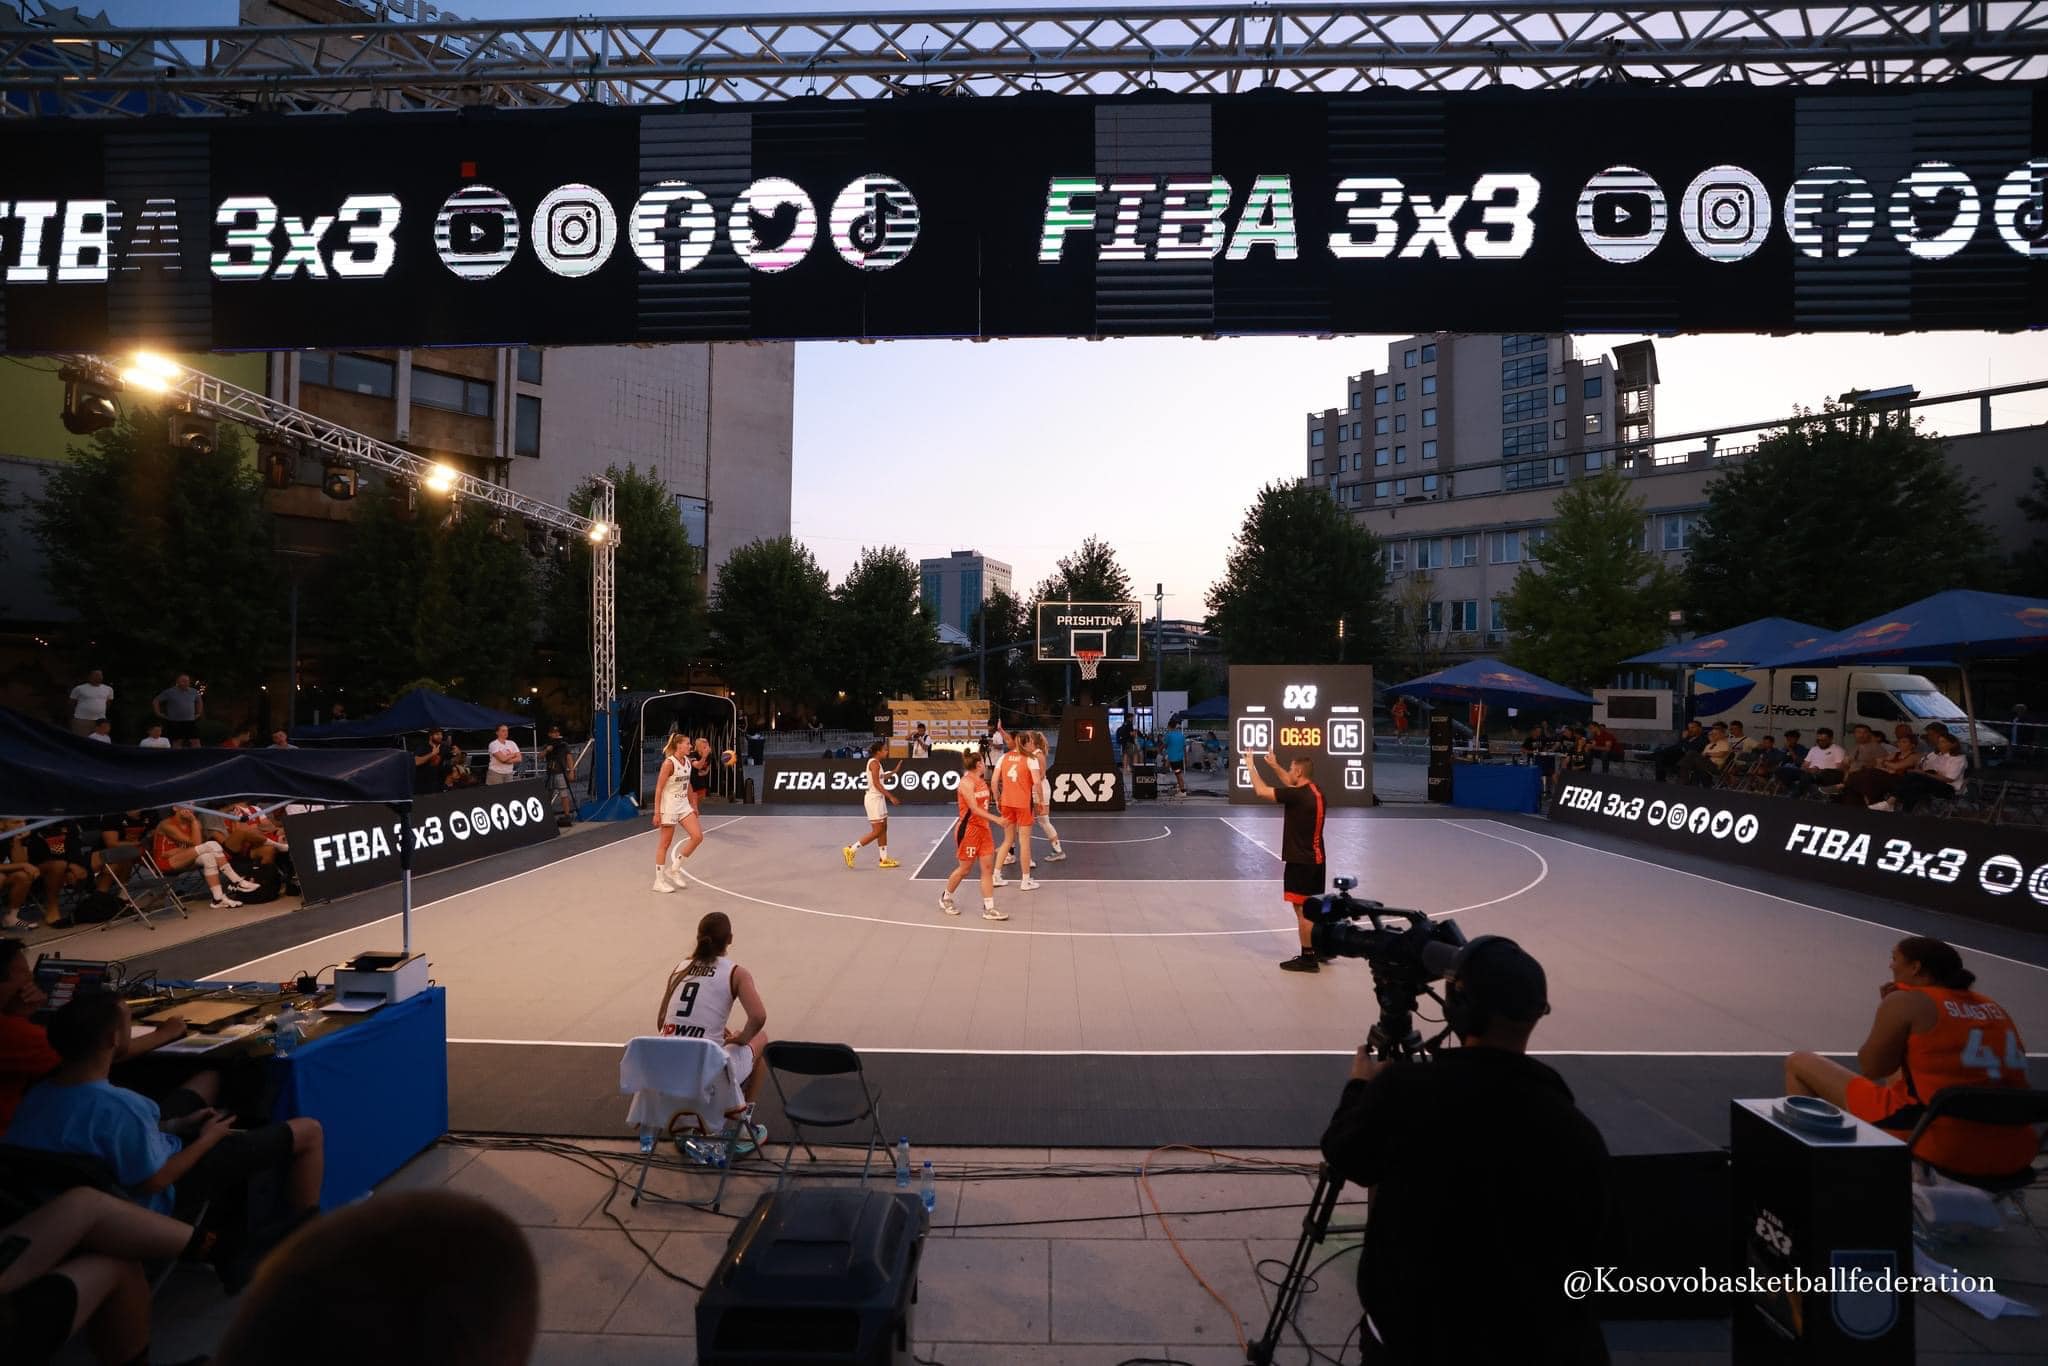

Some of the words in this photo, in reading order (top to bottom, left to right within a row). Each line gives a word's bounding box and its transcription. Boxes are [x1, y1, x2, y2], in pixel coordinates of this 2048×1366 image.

[1038, 174, 1299, 264] FIBA
[1329, 173, 1541, 260] 3x3
[0, 199, 181, 283] IBA
[211, 194, 402, 280] 3x3
[1057, 615, 1123, 626] PRISHTINA
[1243, 723, 1268, 748] 06
[1280, 728, 1321, 746] 06:36
[1334, 724, 1358, 748] 05
[774, 771, 826, 790] FIBA
[1007, 764, 1018, 783] 4
[1351, 771, 1358, 785] 1
[1559, 785, 1602, 813] FIBA
[1602, 793, 1644, 821] 3x3
[313, 826, 391, 872] FIBA
[966, 846, 976, 858] T
[1785, 822, 1872, 866] FIBA
[1876, 838, 1968, 883] 3x3
[676, 982, 700, 1018] 9
